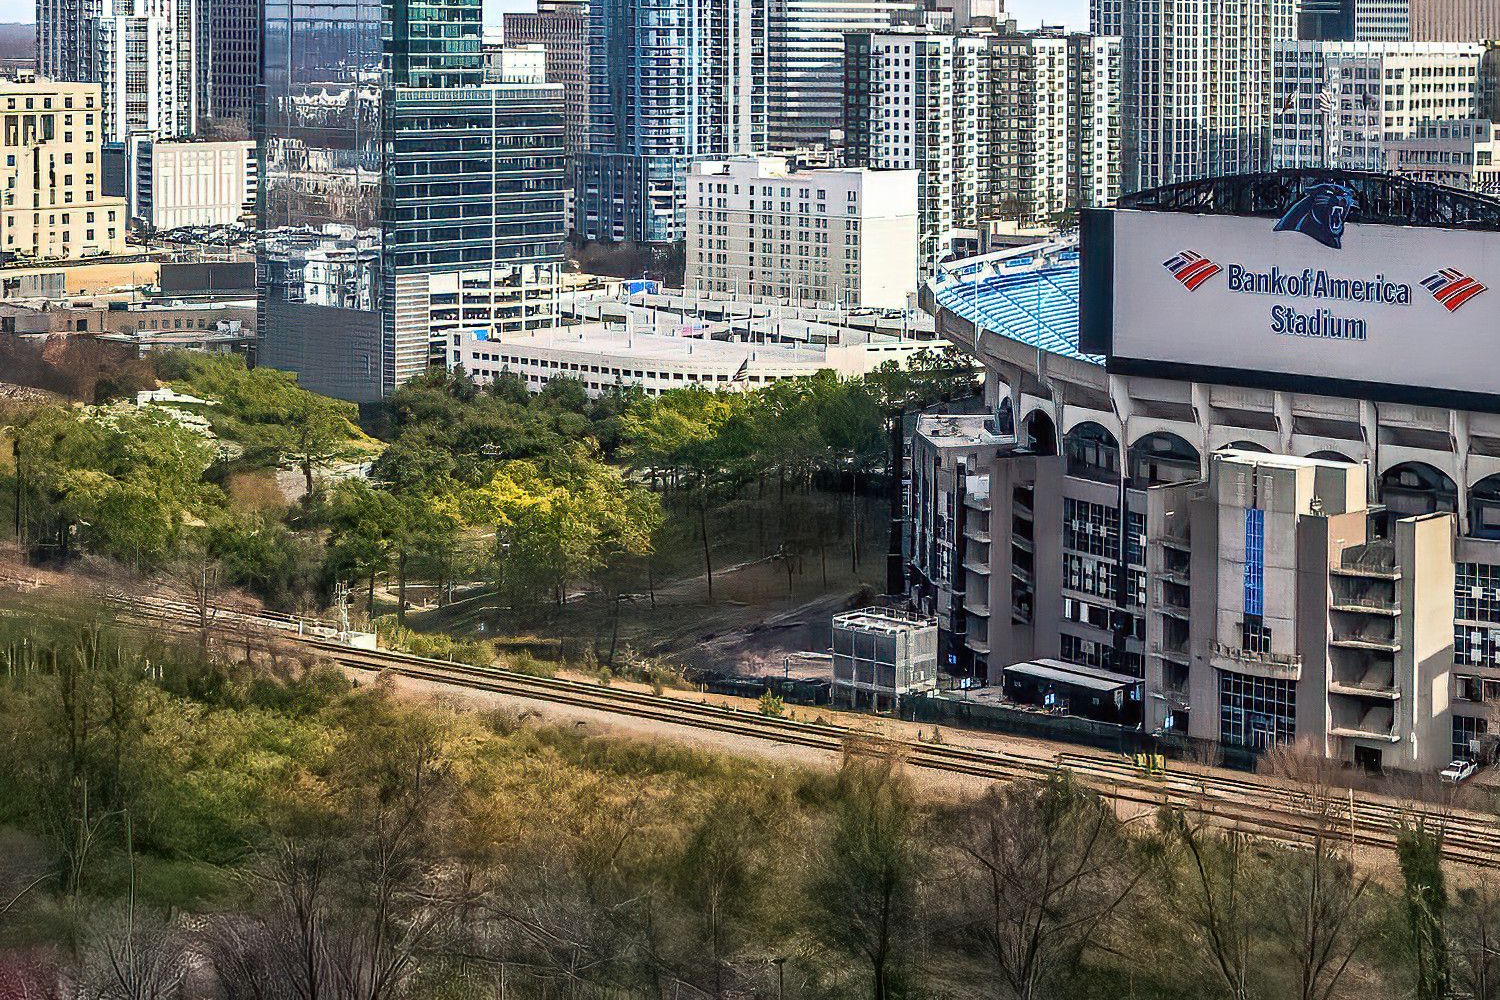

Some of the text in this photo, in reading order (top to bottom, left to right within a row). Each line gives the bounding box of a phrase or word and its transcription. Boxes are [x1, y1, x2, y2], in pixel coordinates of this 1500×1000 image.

[1227, 263, 1285, 294] Bank
[1313, 270, 1412, 304] America
[1270, 304, 1367, 340] Stadium
